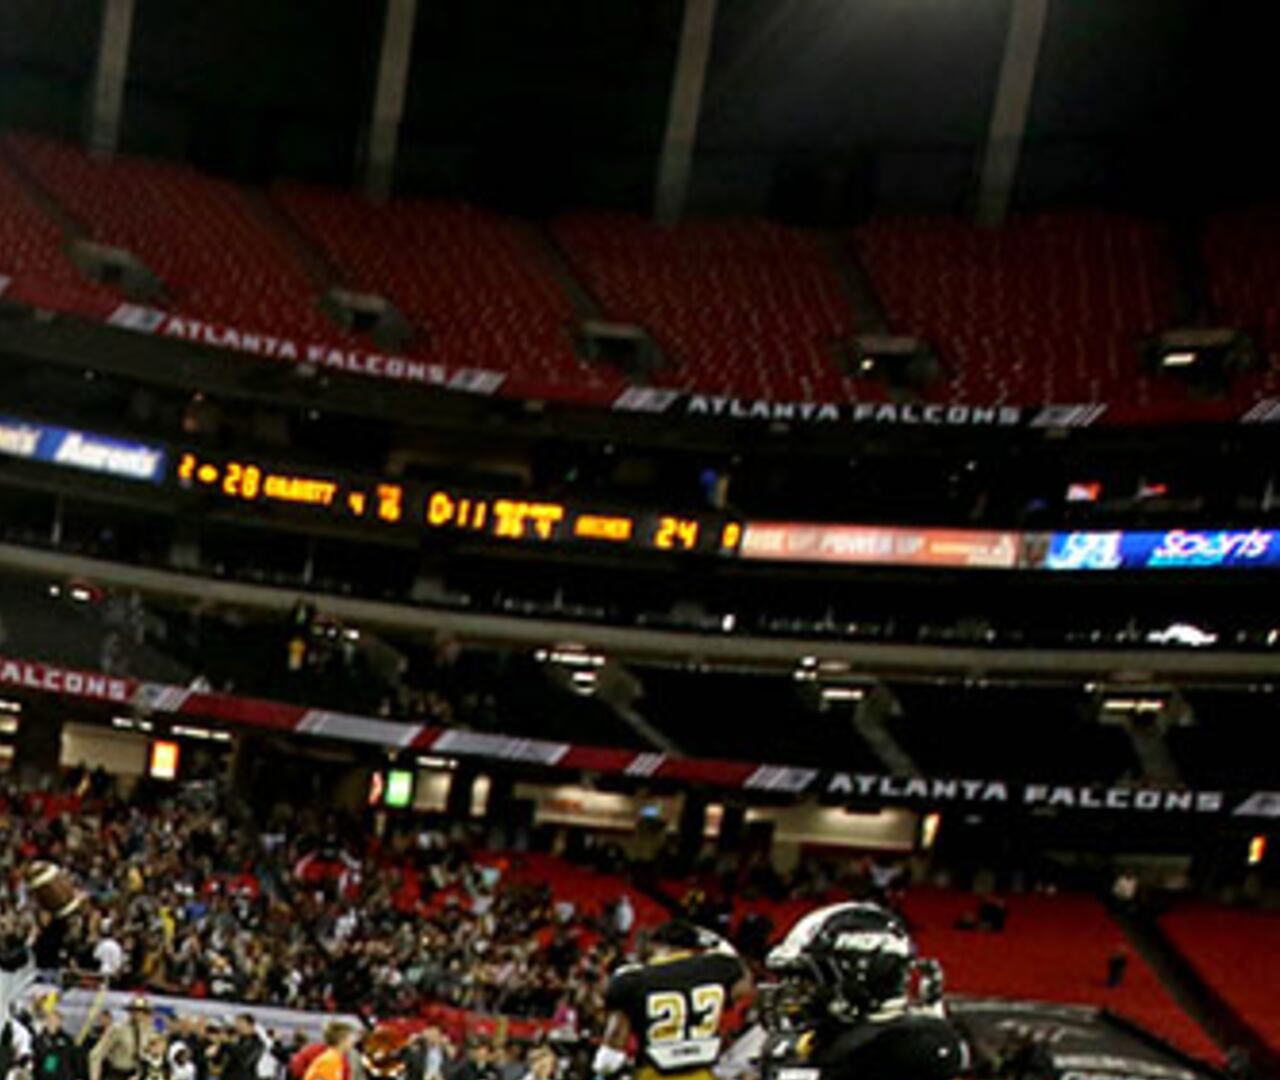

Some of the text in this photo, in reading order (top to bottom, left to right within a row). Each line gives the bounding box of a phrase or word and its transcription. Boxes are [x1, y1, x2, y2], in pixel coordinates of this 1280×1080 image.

[166, 317, 447, 385] ATLANTA FALCONS
[689, 396, 1021, 426] ATLANTA FALCONS
[653, 516, 698, 549] 24
[828, 772, 1224, 812] ATLANTA FALCONS
